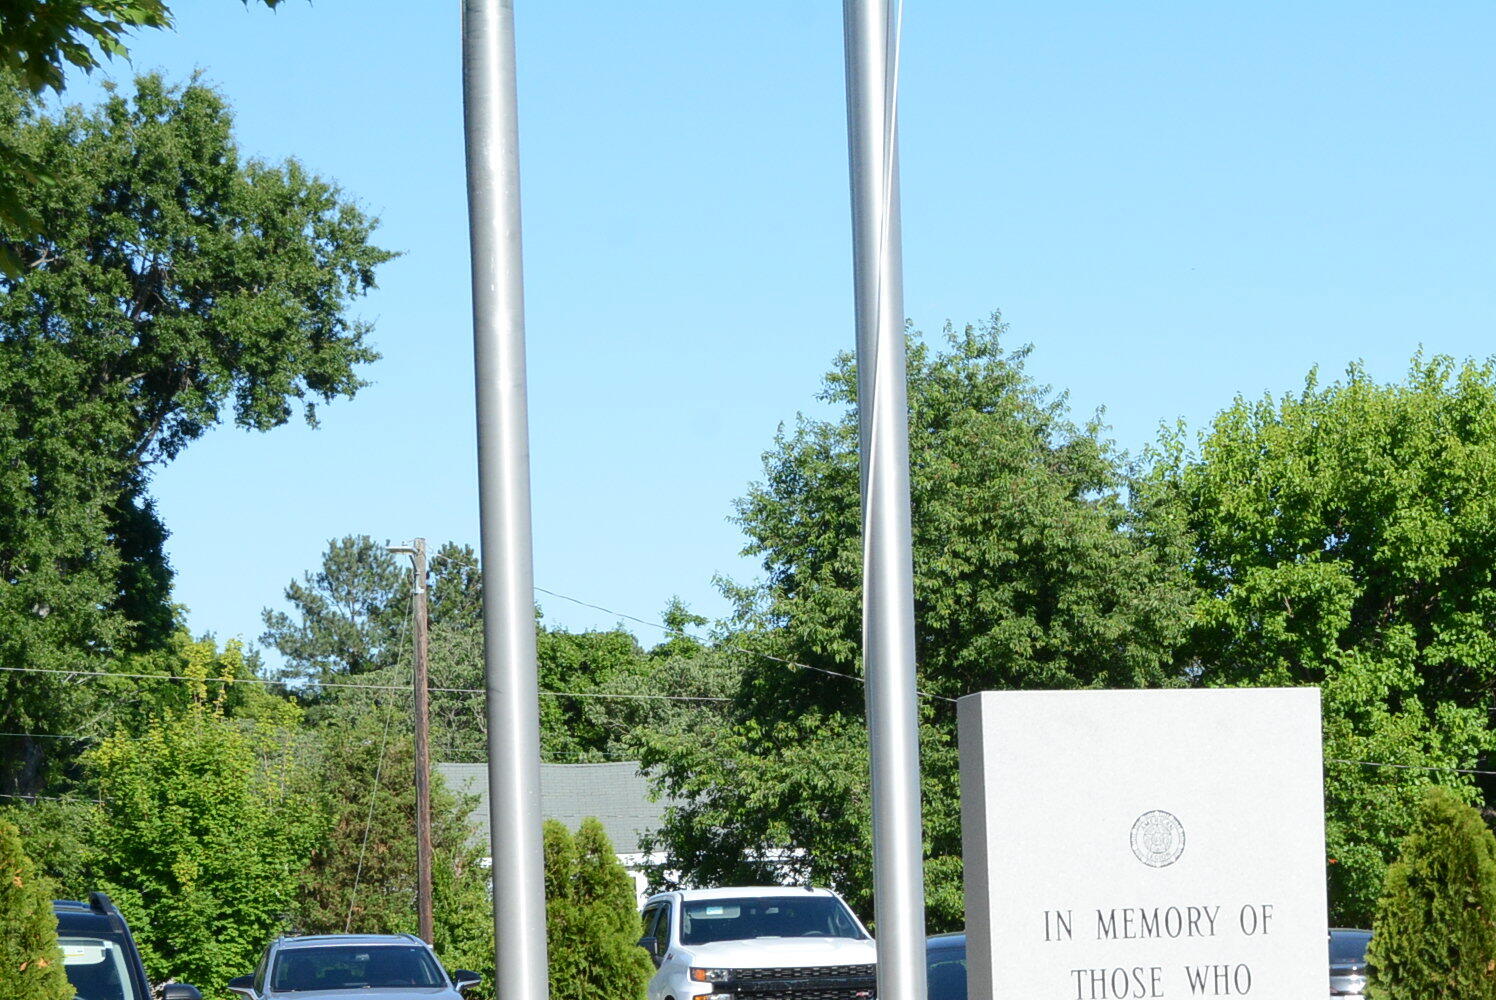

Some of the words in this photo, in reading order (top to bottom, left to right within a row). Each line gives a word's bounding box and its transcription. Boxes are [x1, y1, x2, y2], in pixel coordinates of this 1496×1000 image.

[1043, 909, 1073, 942] IN
[1096, 905, 1221, 941] MEMORY
[1240, 903, 1274, 937] OF
[1071, 966, 1165, 1000] THOSE
[1185, 963, 1252, 996] WHO
